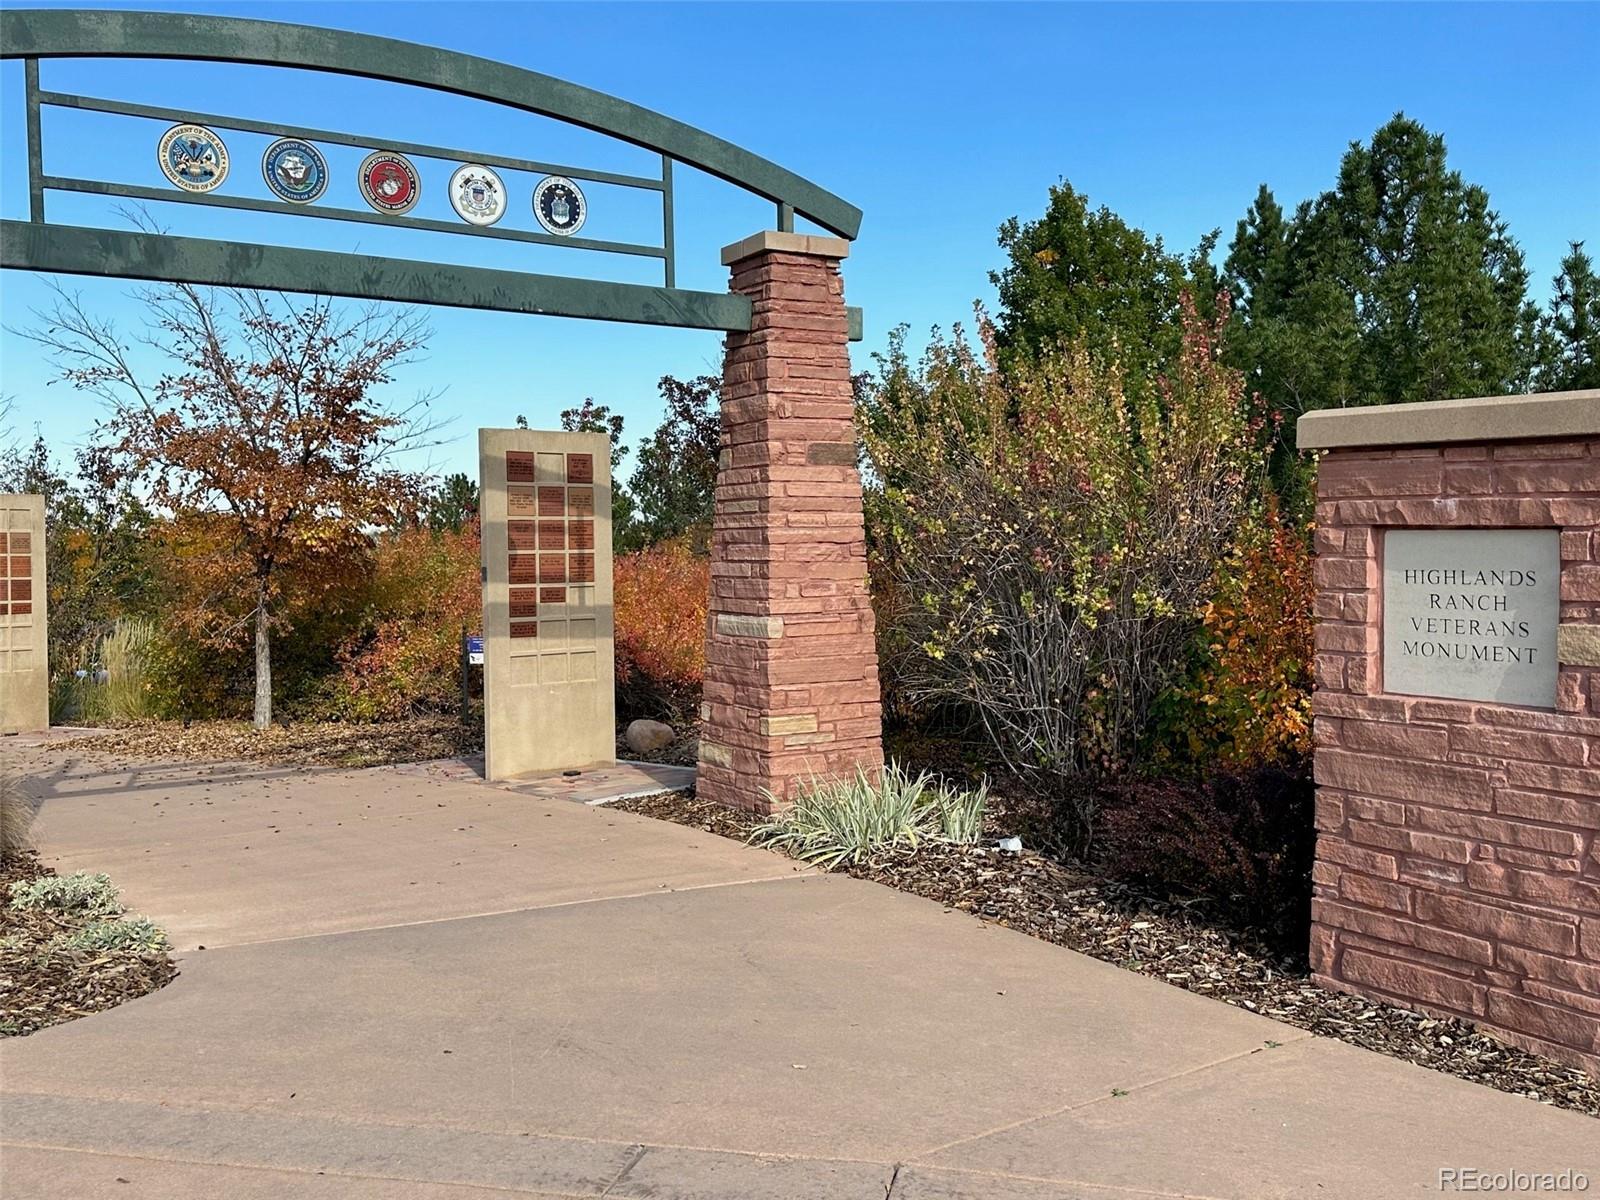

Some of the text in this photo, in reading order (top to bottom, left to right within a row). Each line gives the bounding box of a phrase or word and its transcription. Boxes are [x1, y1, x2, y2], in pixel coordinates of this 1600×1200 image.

[162, 128, 192, 153] DEPARTMENT
[203, 132, 216, 143] THE
[215, 142, 226, 160] ARMY
[268, 143, 298, 163] DEPARTMENT
[162, 159, 178, 180] UNITED
[177, 178, 200, 190] STATES
[209, 166, 226, 187] AMERICA
[365, 156, 392, 174] DEPARTMENT
[1404, 569, 1537, 587] HIGHLANDS
[1429, 593, 1508, 612] RANCH
[1410, 617, 1530, 638] VETERANS
[1402, 640, 1538, 664] MONUMENT
